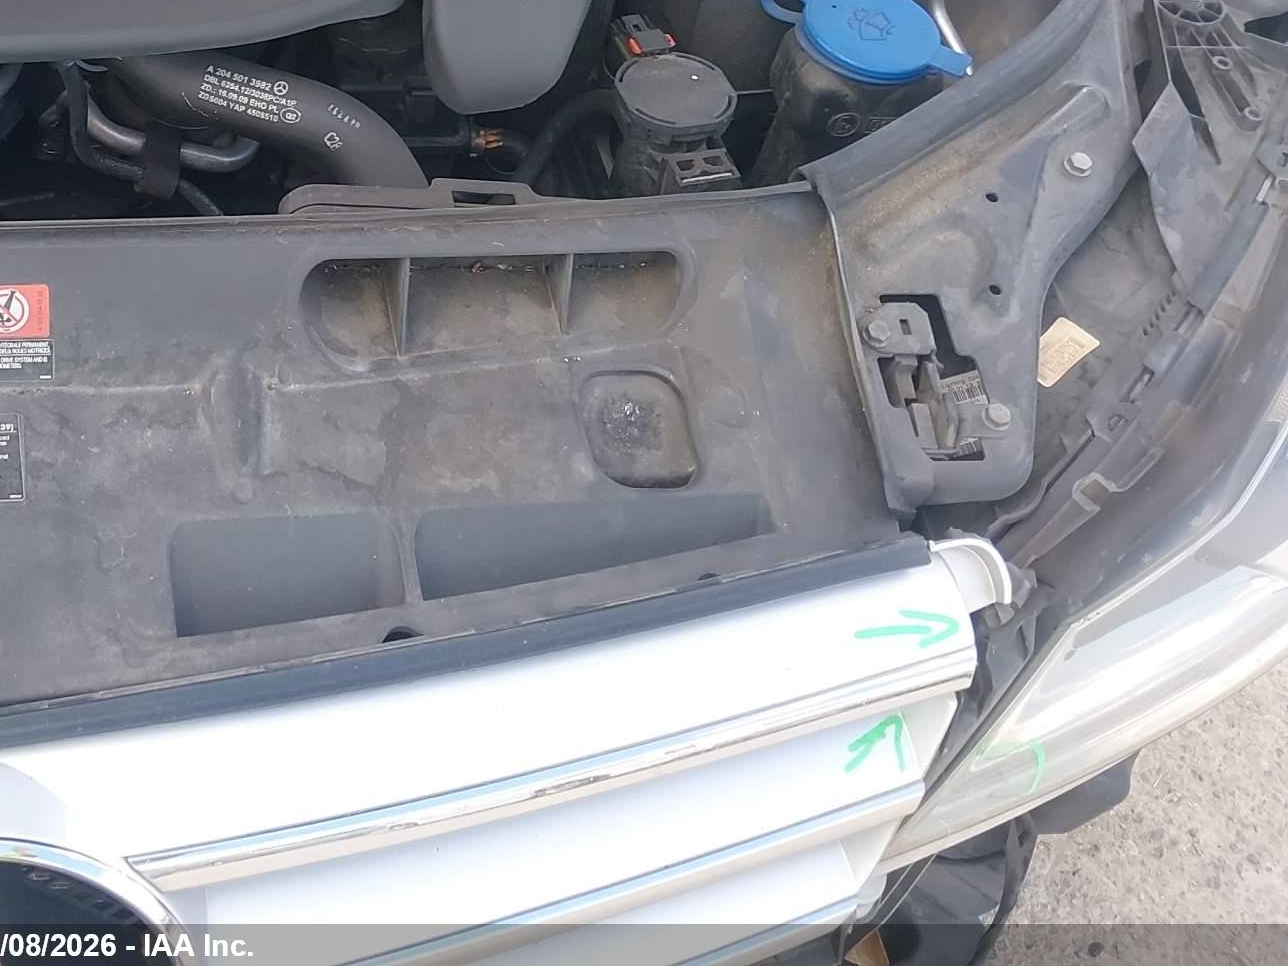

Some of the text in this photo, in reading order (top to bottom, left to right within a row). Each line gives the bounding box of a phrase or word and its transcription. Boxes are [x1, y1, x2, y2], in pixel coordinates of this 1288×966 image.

[206, 65, 214, 74] A
[215, 68, 232, 78] 204
[233, 73, 249, 84] 501
[229, 101, 246, 113] YAP
